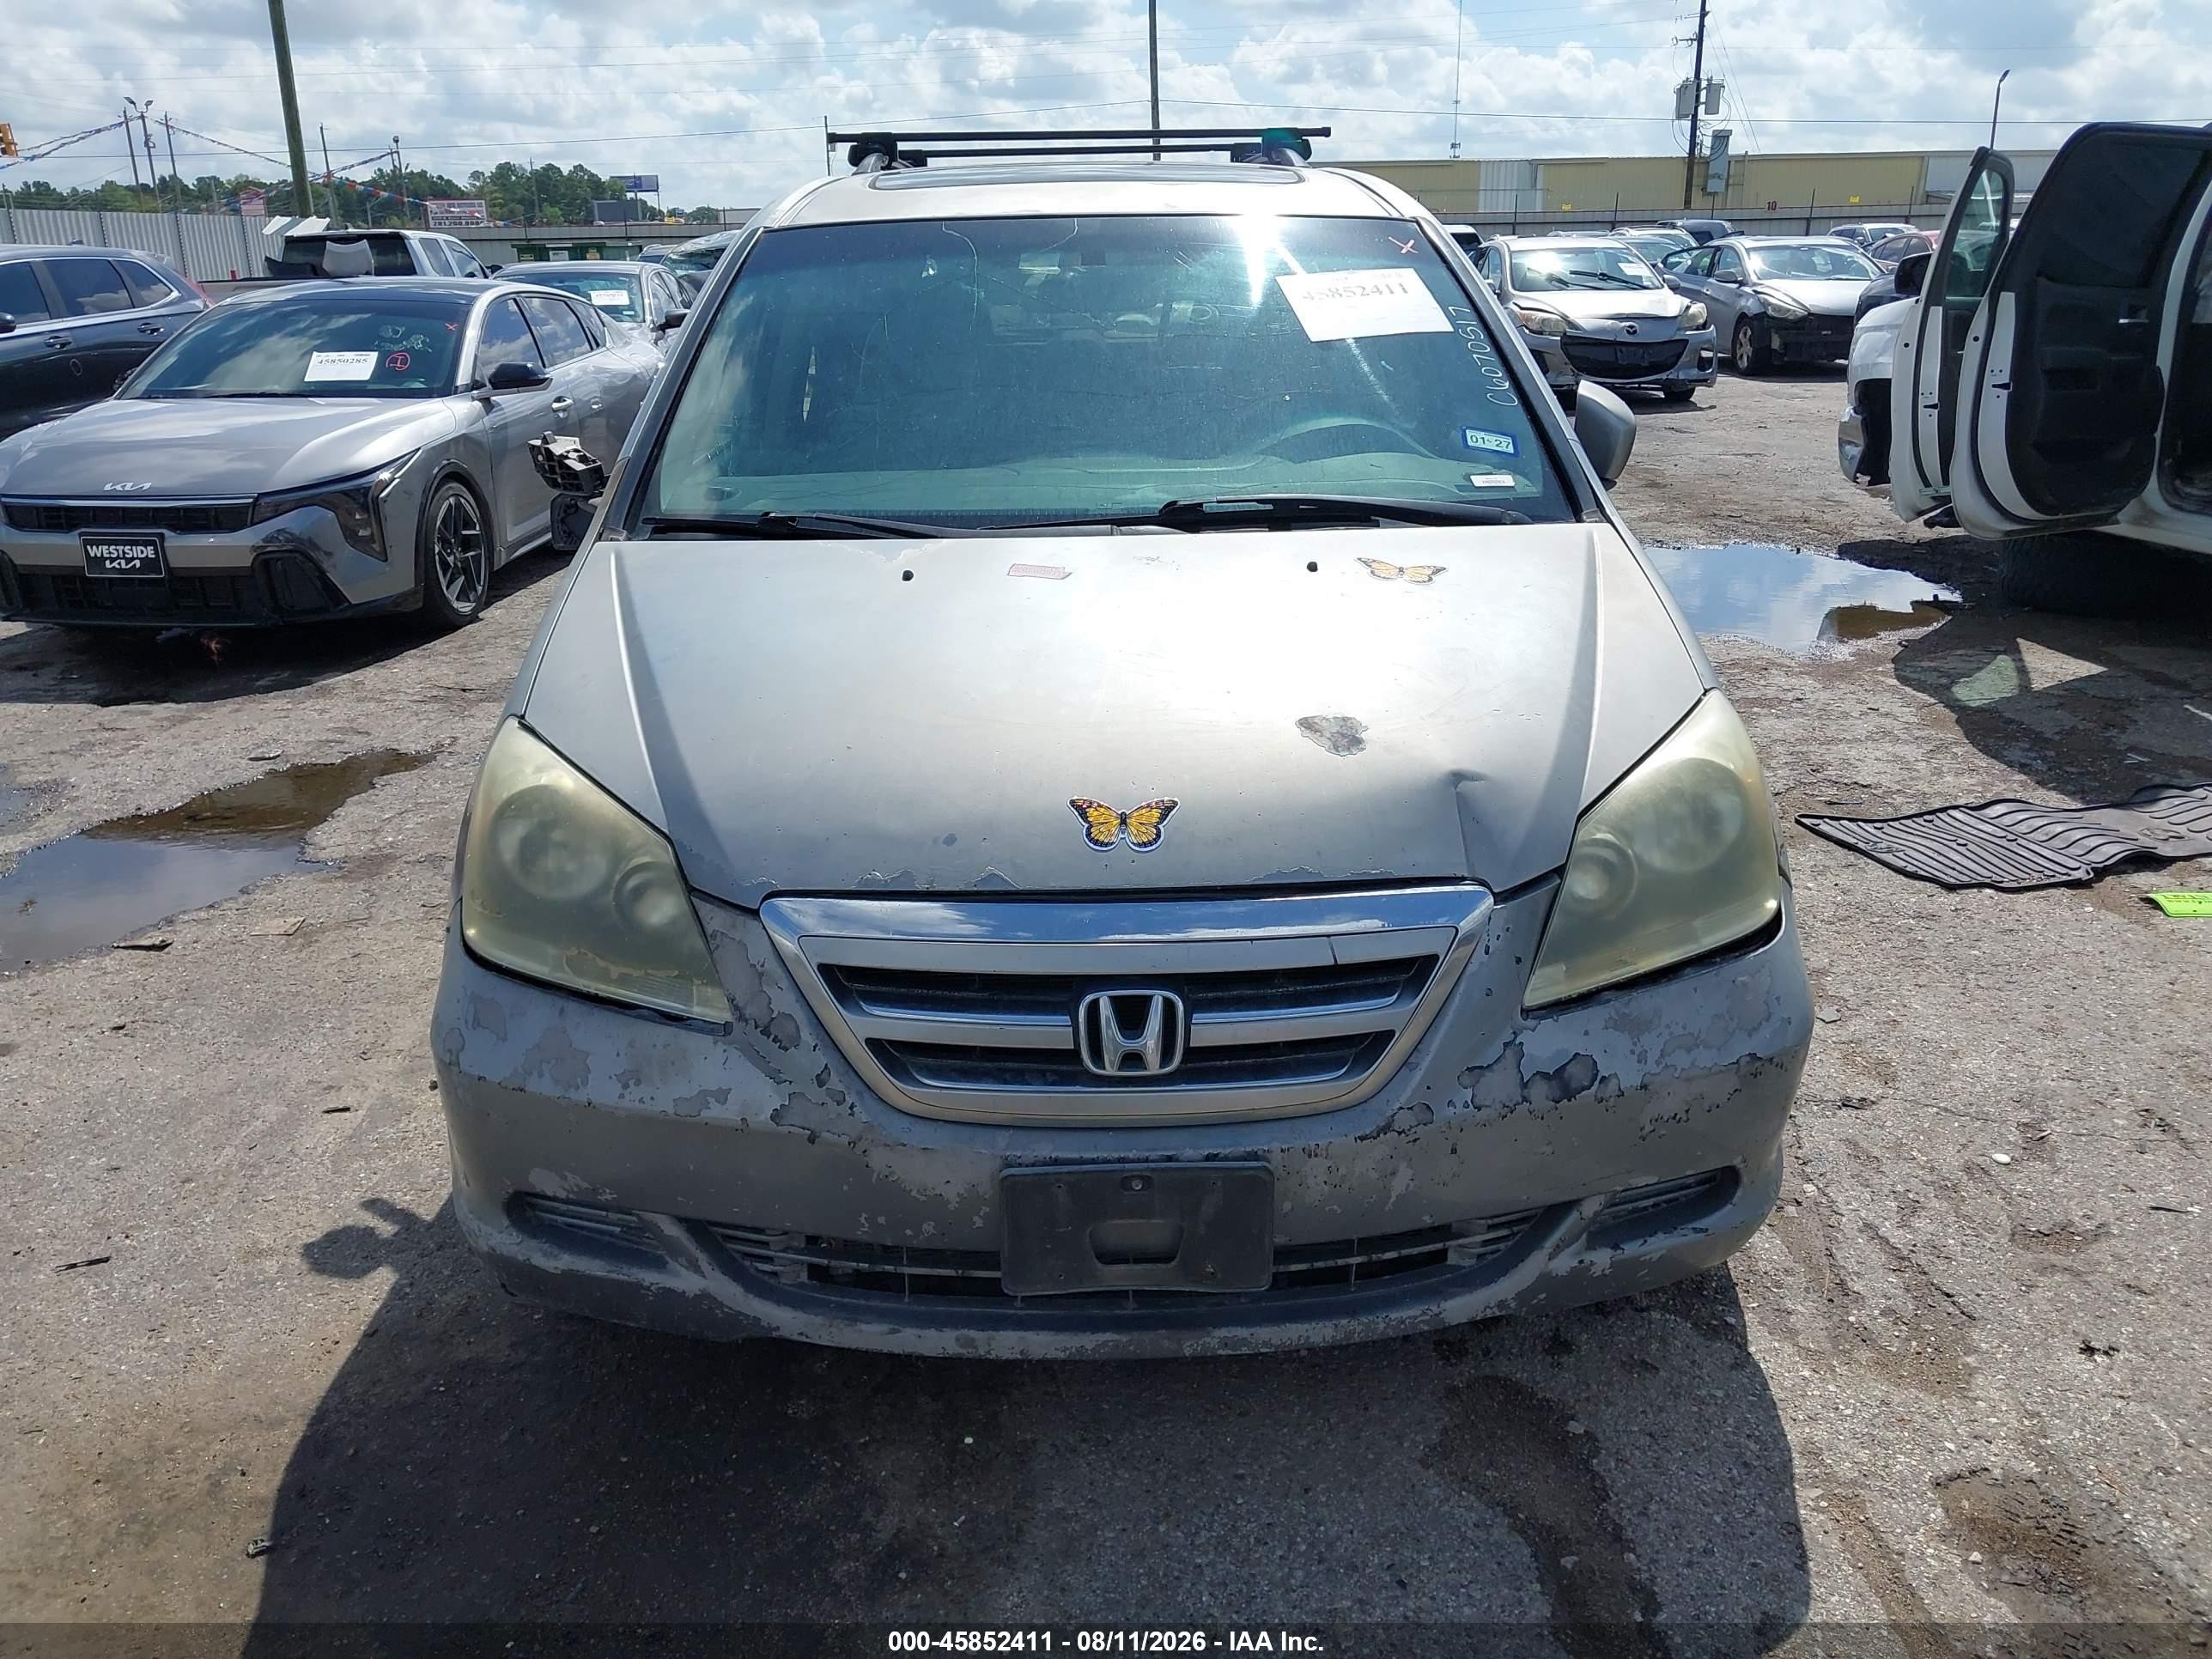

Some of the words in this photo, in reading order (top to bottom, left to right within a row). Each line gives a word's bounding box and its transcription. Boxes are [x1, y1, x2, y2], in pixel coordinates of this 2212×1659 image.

[1766, 200, 1778, 211] 10
[1302, 283, 1409, 301] 45852411
[1448, 305, 1519, 407] C6070517
[86, 544, 155, 558] WESTSIDE
